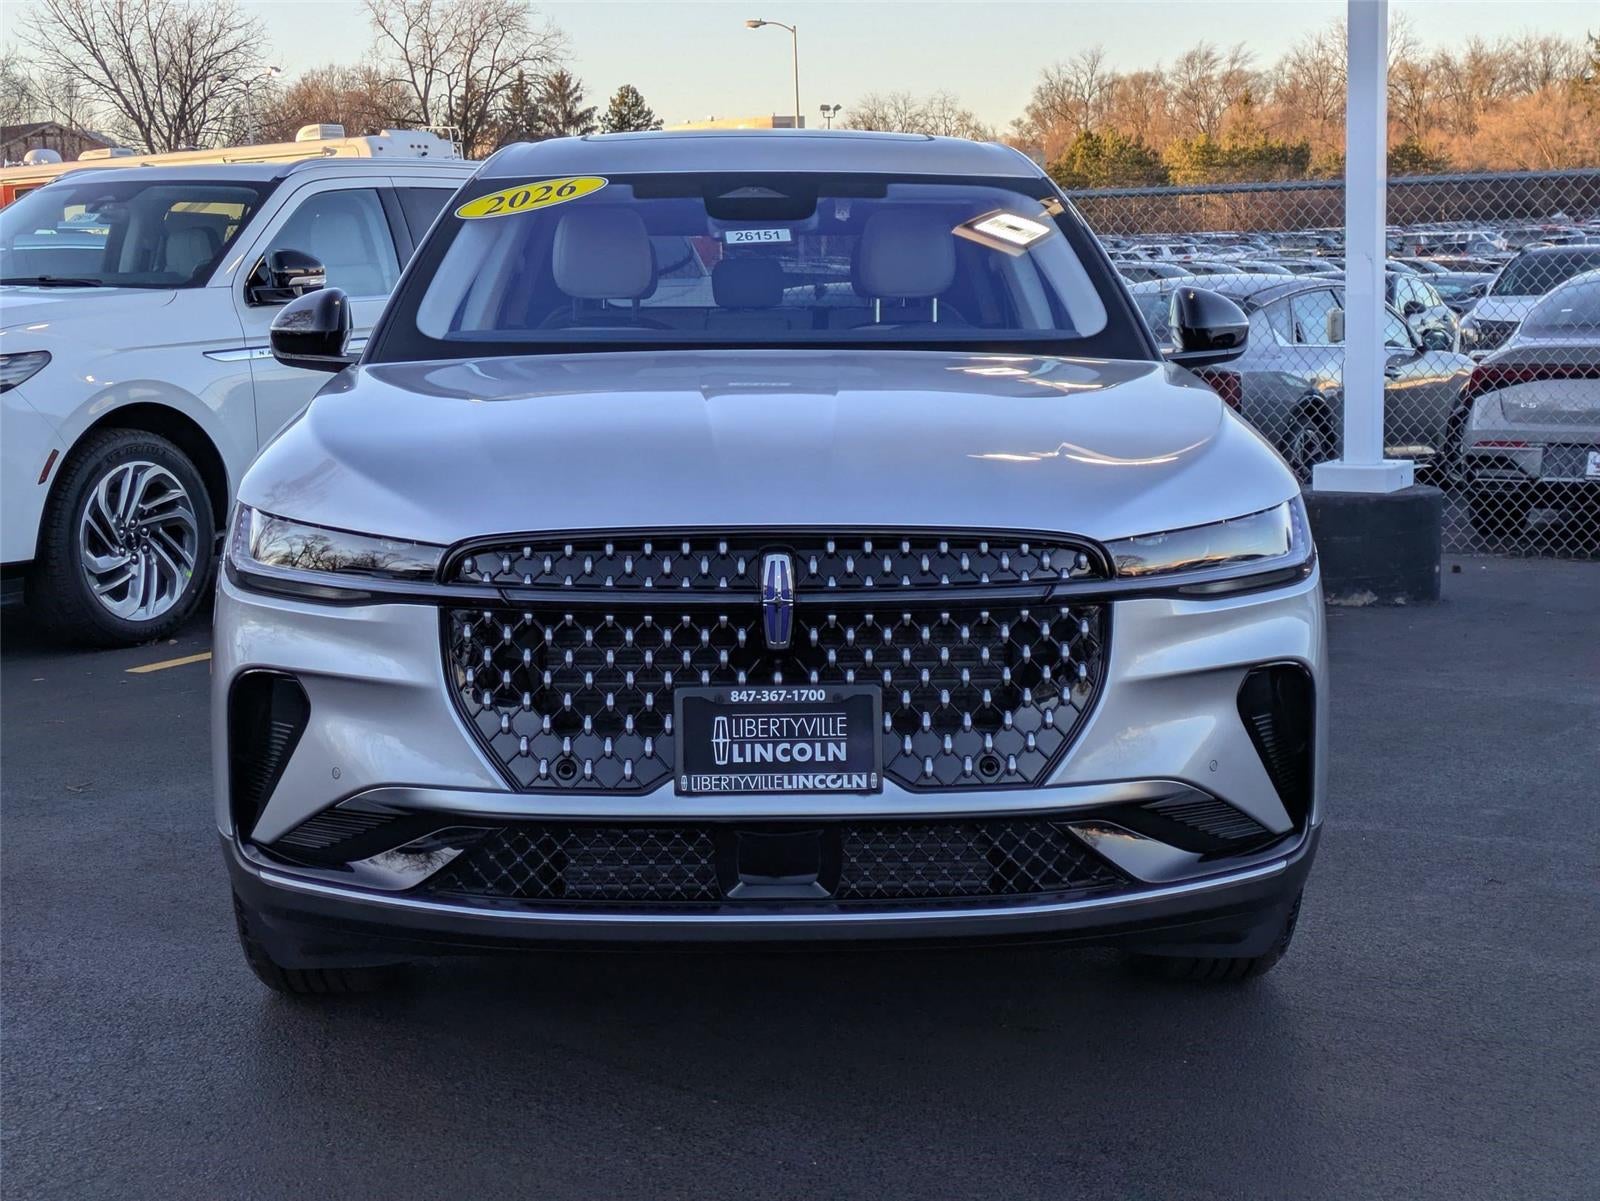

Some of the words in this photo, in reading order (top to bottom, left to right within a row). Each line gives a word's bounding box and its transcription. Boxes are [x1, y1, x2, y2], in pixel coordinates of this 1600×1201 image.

[482, 178, 579, 216] 2026
[735, 230, 780, 242] 26151
[730, 689, 826, 702] 847-367-1700
[731, 716, 848, 738] LIBERTYVILLE
[731, 742, 847, 763] LINCOLN
